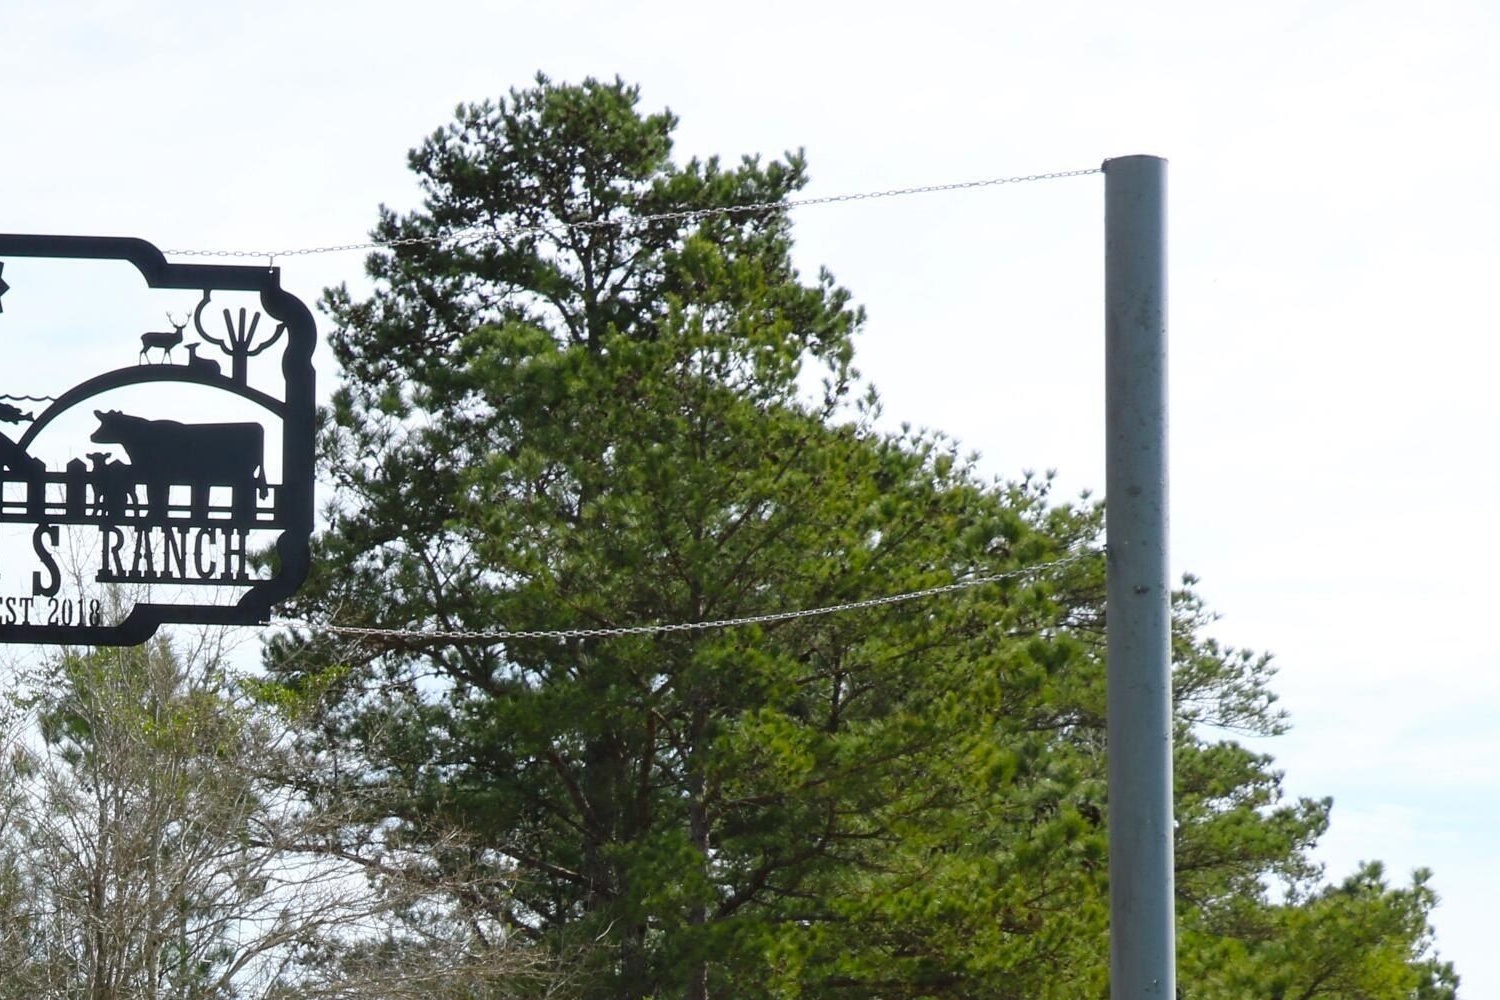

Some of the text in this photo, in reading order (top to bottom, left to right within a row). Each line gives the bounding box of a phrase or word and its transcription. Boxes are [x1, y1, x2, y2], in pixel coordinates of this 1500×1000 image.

[32, 523, 61, 597] S
[97, 524, 251, 581] RANCH
[48, 597, 101, 628] 2018
